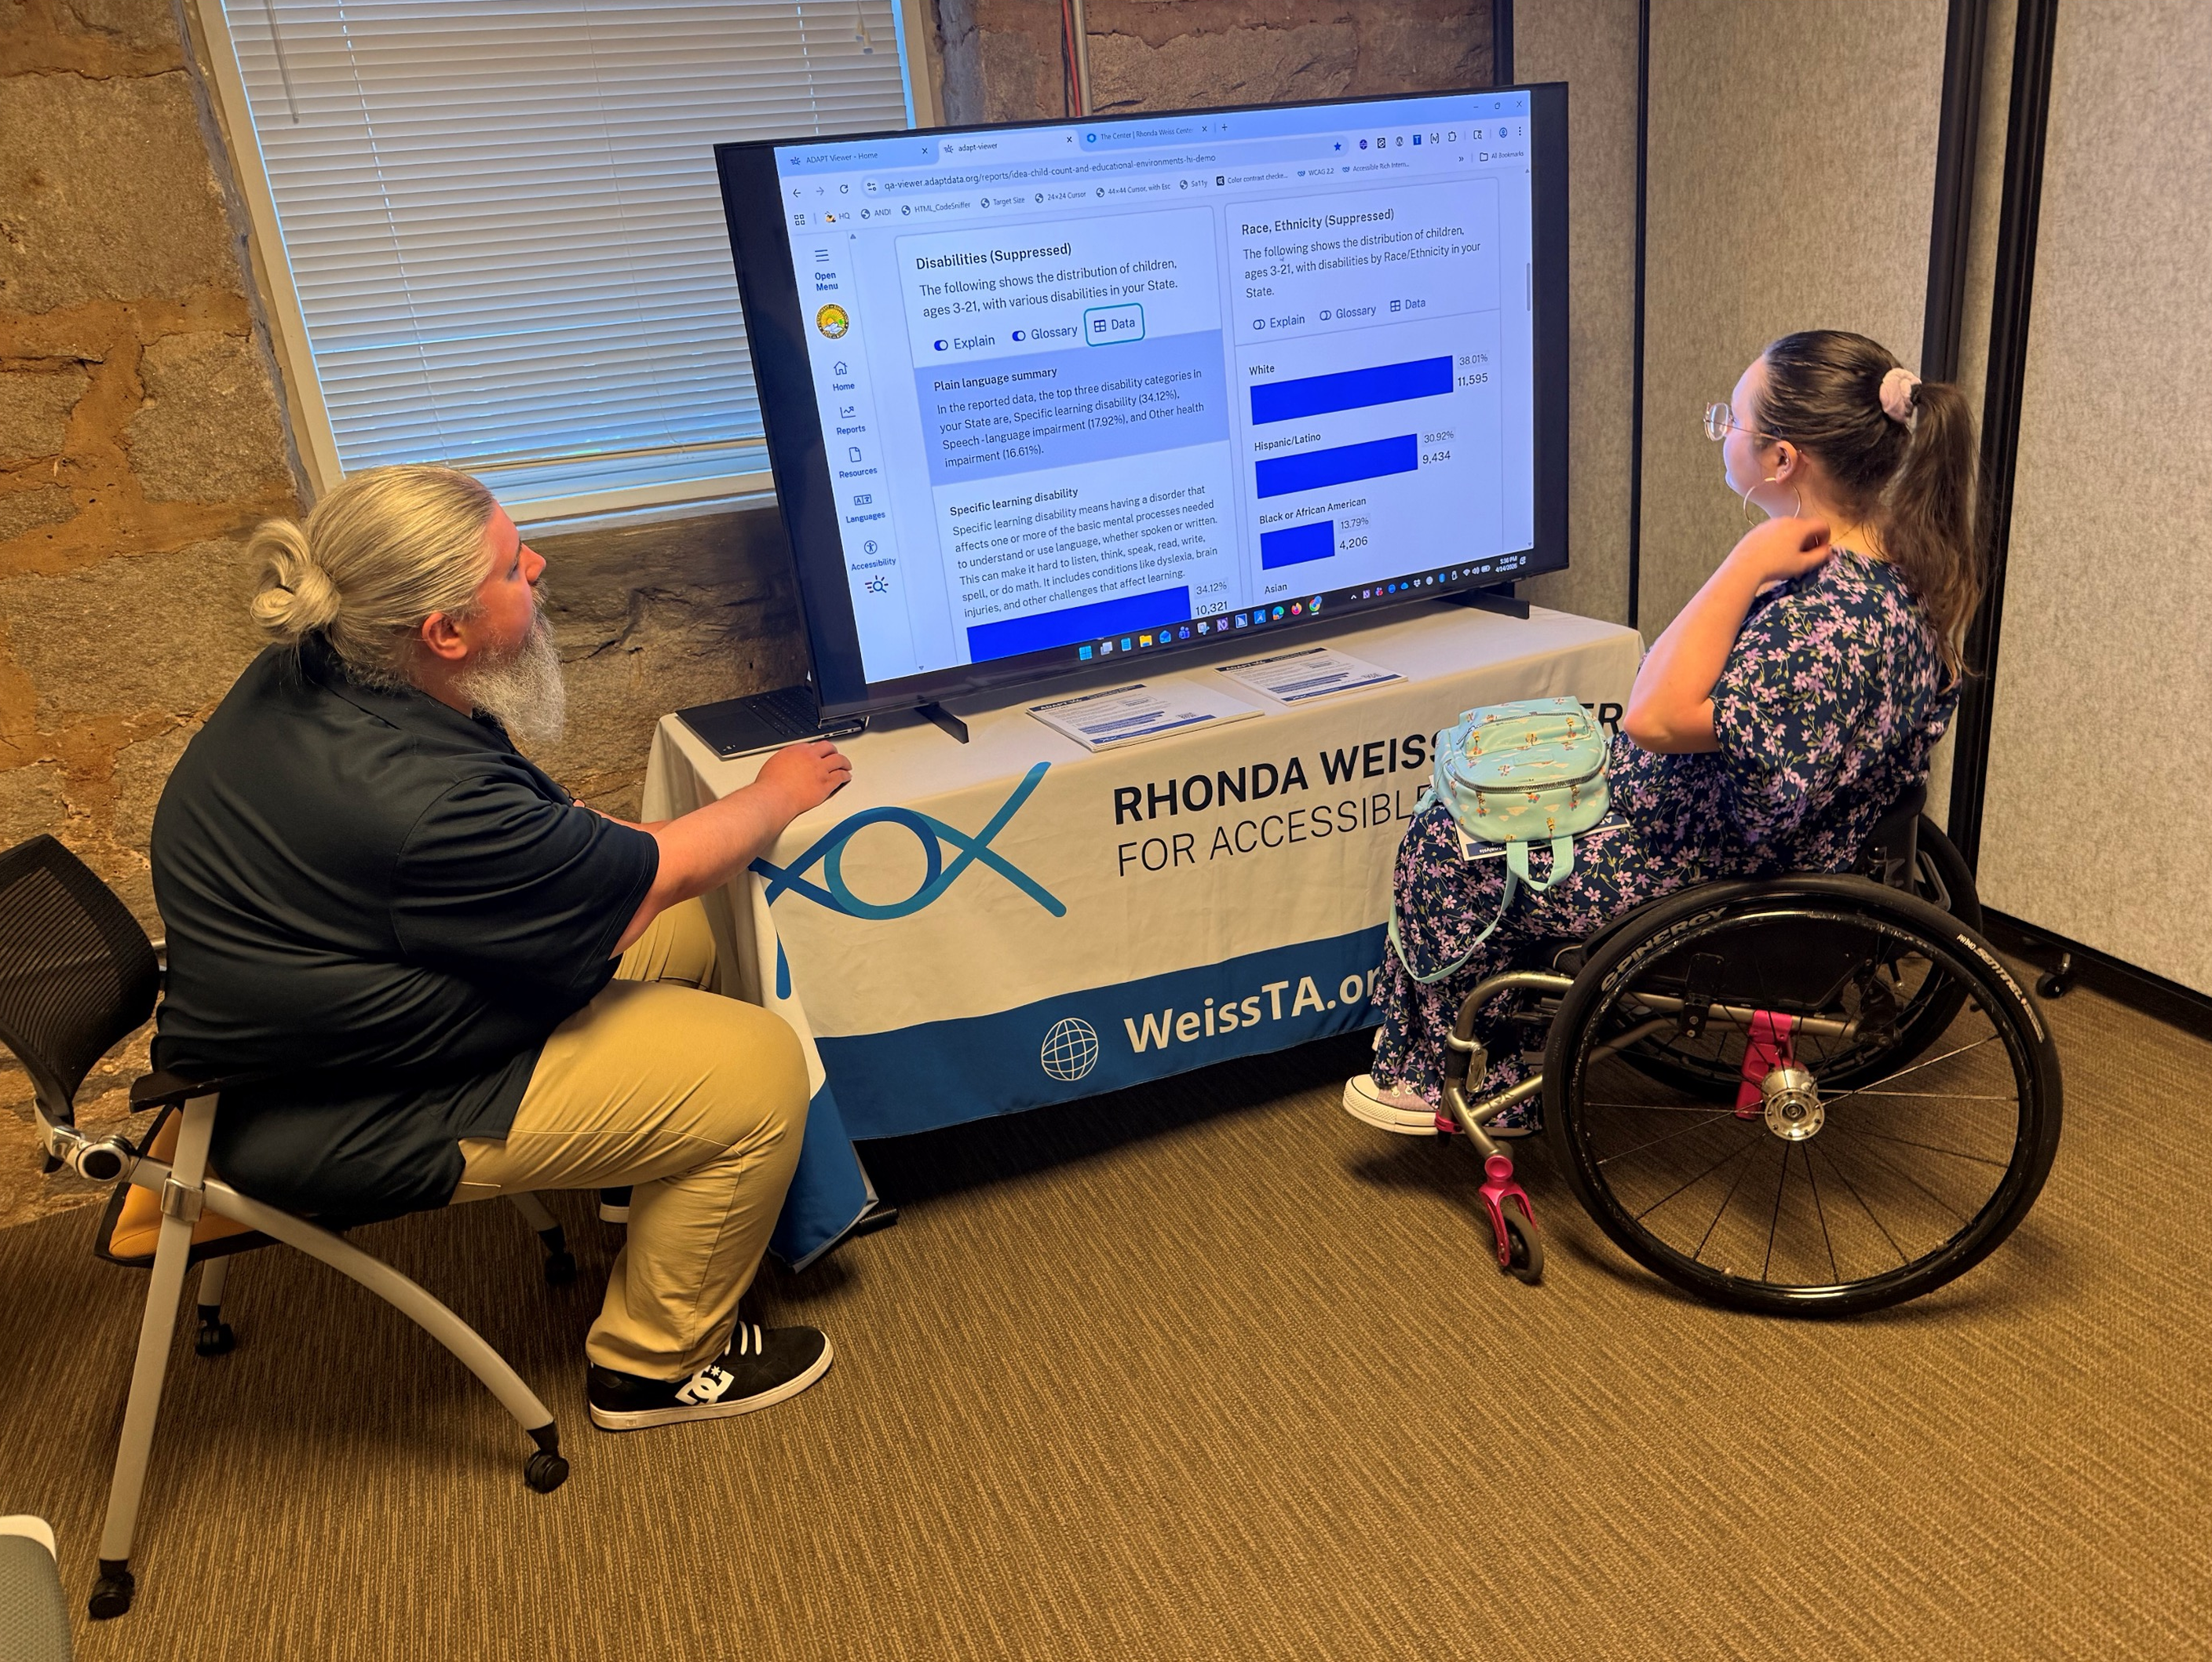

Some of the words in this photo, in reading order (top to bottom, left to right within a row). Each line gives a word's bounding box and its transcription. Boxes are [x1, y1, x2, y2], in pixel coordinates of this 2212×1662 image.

[958, 142, 998, 153] adapt-viewer
[805, 155, 829, 165] ADAPT
[829, 154, 852, 163] Viewer
[914, 201, 971, 214] HTML_CodeSniffer
[993, 198, 1013, 207] Target
[1013, 196, 1025, 205] Size
[838, 212, 851, 221] HQ
[874, 208, 892, 217] ANDI
[1241, 224, 1272, 236] Race,
[1275, 217, 1323, 232] Ethnicity
[1324, 208, 1395, 228] (Suppressed)
[1243, 248, 1262, 260] The
[1264, 243, 1309, 257] following
[1310, 241, 1341, 253] shows
[1342, 237, 1359, 249] the
[1360, 231, 1413, 247] distribution
[1414, 228, 1425, 240] of
[916, 253, 987, 270] Disabilities
[990, 242, 1072, 265] (Suppressed)
[1244, 268, 1268, 281] ages
[1270, 263, 1294, 276] 3-21,
[1295, 261, 1317, 273] with
[1318, 255, 1369, 270] disabilities
[1371, 253, 1382, 266] by
[1384, 245, 1450, 263] Race/Ethnicity
[1451, 243, 1460, 254] in
[1461, 243, 1481, 255] your
[814, 272, 837, 282] Open
[918, 284, 942, 297] The
[944, 279, 997, 294] following
[998, 276, 1035, 288] shows
[1036, 272, 1055, 284] the
[1056, 265, 1118, 282] distribution
[1119, 262, 1130, 275] of
[1132, 259, 1177, 273] children,
[816, 283, 839, 292] Menu
[1246, 287, 1275, 299] State.
[923, 306, 951, 320] ages
[952, 300, 981, 314] 3-21,
[982, 297, 1007, 311] with
[1009, 294, 1049, 308] various
[1050, 287, 1108, 303] disabilities
[1110, 284, 1120, 296] in
[1122, 283, 1145, 298] your
[1148, 279, 1178, 291] State.
[1405, 298, 1426, 310] Data
[1335, 306, 1377, 320] Glossary
[1111, 318, 1136, 331] Data
[1270, 314, 1305, 329] Explain
[1031, 326, 1079, 341] Glossary
[954, 334, 996, 351] Explain
[1459, 353, 1488, 367] 38.01%
[1249, 364, 1276, 376] White
[933, 379, 961, 393] Plain
[962, 374, 1009, 389] language
[1011, 368, 1057, 382] summary
[1457, 372, 1488, 387] 11,595
[832, 383, 856, 392] Home
[937, 404, 947, 415] In
[949, 402, 966, 413] the
[968, 395, 1011, 411] reported
[1012, 393, 1038, 405] data,
[1038, 389, 1055, 401] the
[1056, 389, 1073, 400] top
[1074, 385, 1100, 396] three
[1101, 378, 1144, 393] disability
[1144, 371, 1192, 386] categories
[1193, 369, 1203, 378] in
[940, 422, 963, 435] your
[962, 415, 991, 429] State
[993, 416, 1012, 426] are,
[1013, 407, 1053, 424] Specific
[1054, 403, 1093, 417] learning
[1095, 396, 1137, 411] disability
[1032, 421, 1086, 437] impairment
[1130, 410, 1148, 422] and
[1148, 407, 1175, 420] Other
[1176, 402, 1205, 415] health
[836, 425, 867, 436] Reports
[1424, 430, 1455, 444] 30.92%
[1254, 433, 1322, 452] Hispanic/Latino
[944, 451, 1001, 469] impairment
[1002, 444, 1045, 461] (16.61%).
[1422, 450, 1451, 465] 9,434
[838, 467, 878, 479] Resources
[950, 502, 991, 517] Specific
[991, 496, 1033, 510] learning
[1034, 488, 1079, 502] disability
[845, 512, 886, 524] Languages
[952, 521, 993, 537] Specific
[994, 516, 1034, 530] learning
[1035, 508, 1077, 523] disability
[1079, 503, 1109, 516] means
[1110, 498, 1141, 510] having
[1149, 489, 1186, 503] disorder
[1188, 485, 1206, 496] that
[1259, 512, 1283, 525] Black
[1295, 506, 1326, 518] African
[1327, 499, 1367, 512] American
[955, 539, 990, 553] affects
[991, 537, 1009, 547] one
[1010, 535, 1020, 544] or
[1022, 531, 1047, 542] more
[1048, 526, 1058, 538] of
[1060, 525, 1076, 535] the
[1076, 520, 1101, 532] basic
[1103, 513, 1135, 528] mental
[1136, 507, 1181, 524] processes
[1182, 499, 1215, 514] needed
[1341, 517, 1370, 530] 13.79%
[1339, 535, 1368, 550] 4,206
[851, 558, 896, 572] Accessibility
[1195, 581, 1228, 595] 34.12%
[1265, 583, 1288, 595] Asian
[1195, 600, 1228, 616] 10,321
[1114, 756, 1309, 825] RHONDA
[1118, 833, 1195, 877] FOR
[1601, 907, 1727, 992] SPINERGY
